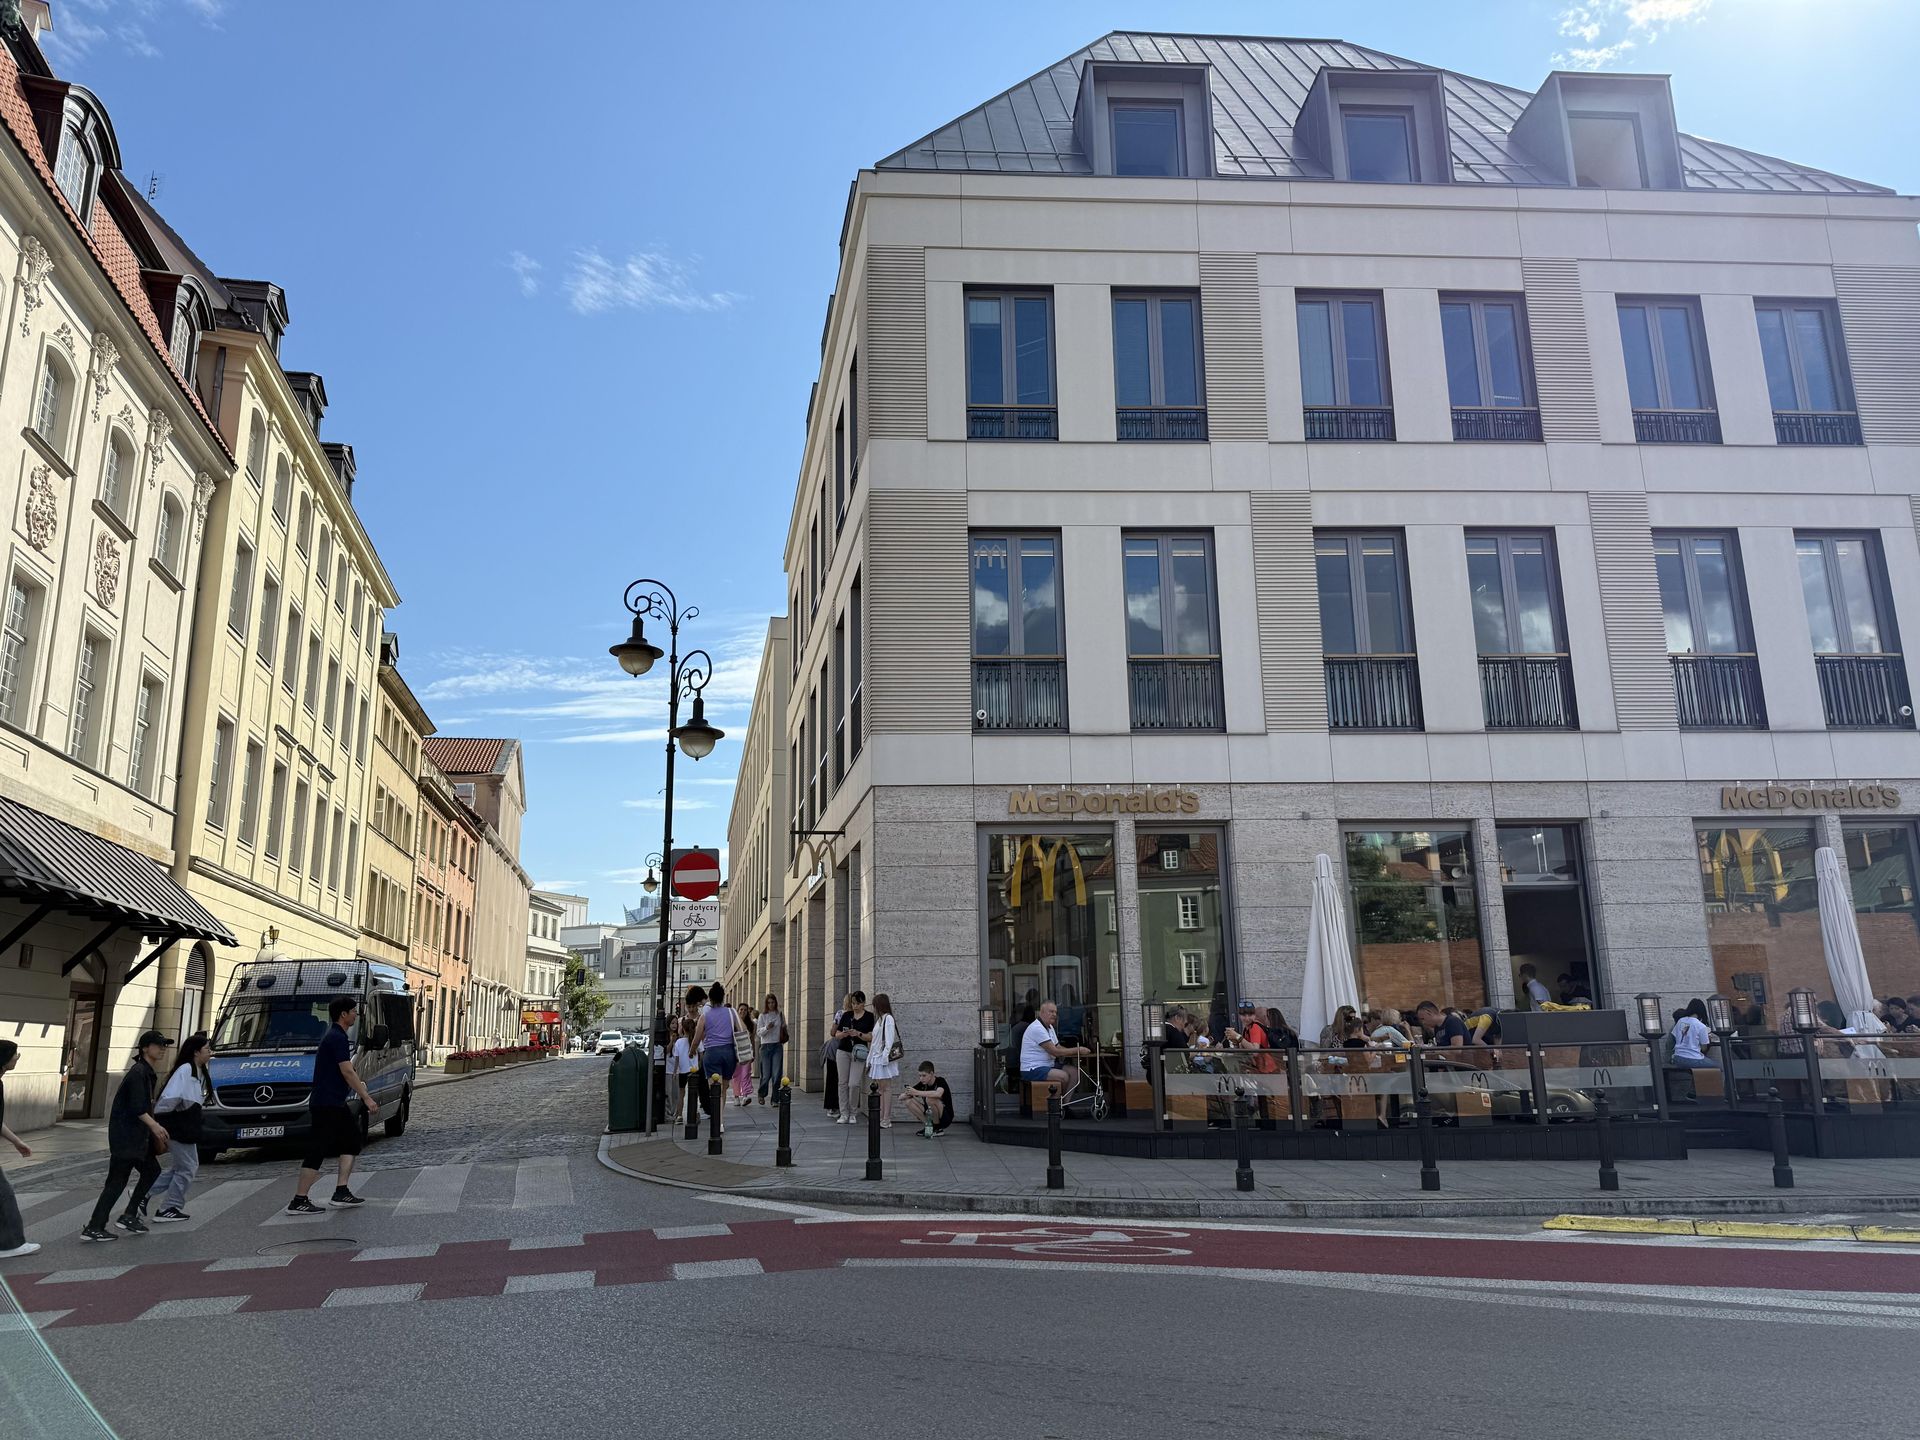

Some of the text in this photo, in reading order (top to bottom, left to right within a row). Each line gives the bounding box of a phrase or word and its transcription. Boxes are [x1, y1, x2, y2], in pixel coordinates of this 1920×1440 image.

[1009, 790, 1200, 813] McDonald's
[1721, 785, 1901, 810] McDonald's
[688, 904, 718, 912] dotyczy
[240, 1060, 301, 1070] POLICJA
